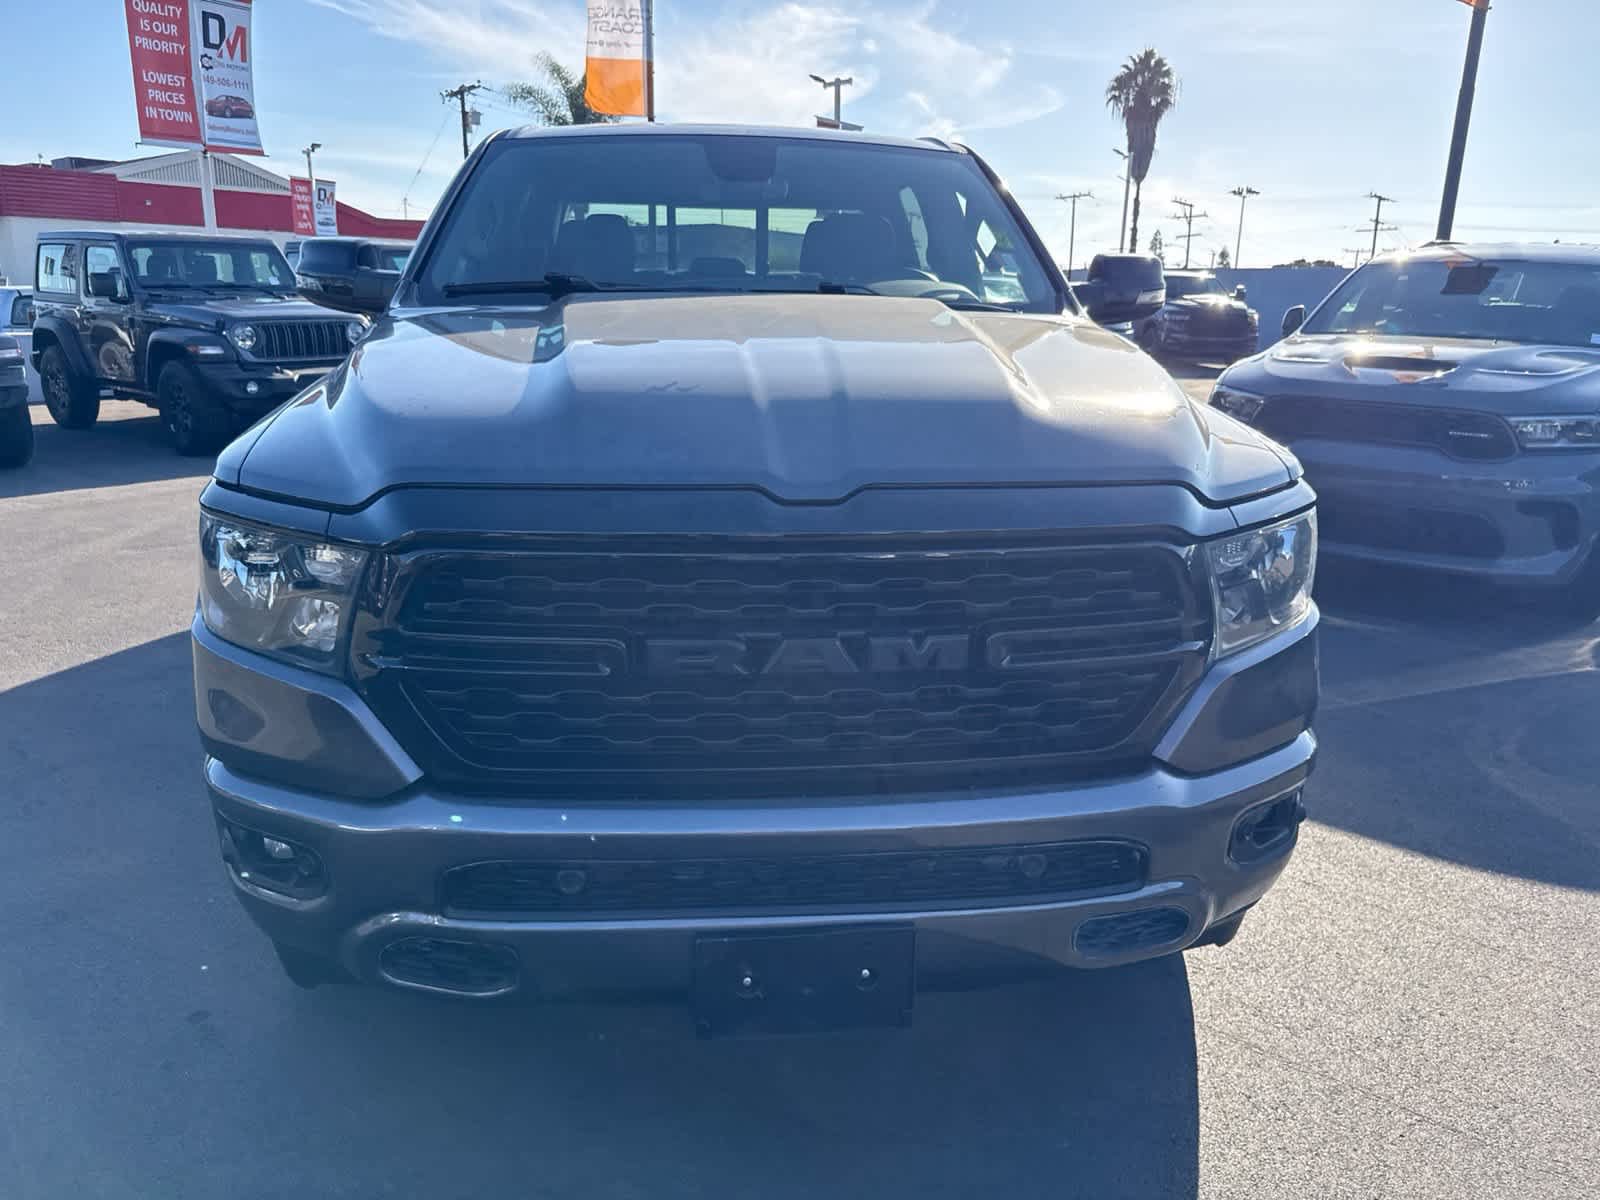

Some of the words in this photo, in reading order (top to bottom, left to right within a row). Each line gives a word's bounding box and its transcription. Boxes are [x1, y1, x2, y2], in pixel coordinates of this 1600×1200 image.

[132, 0, 183, 19] QUALITY
[140, 19, 151, 31] IS
[152, 21, 178, 36] OUR
[134, 35, 186, 55] PRIORITY
[142, 71, 186, 88] LOWEST
[148, 89, 186, 105] PRICES
[145, 106, 158, 119] IN
[160, 108, 193, 123] TOWN
[644, 630, 970, 675] RAM
